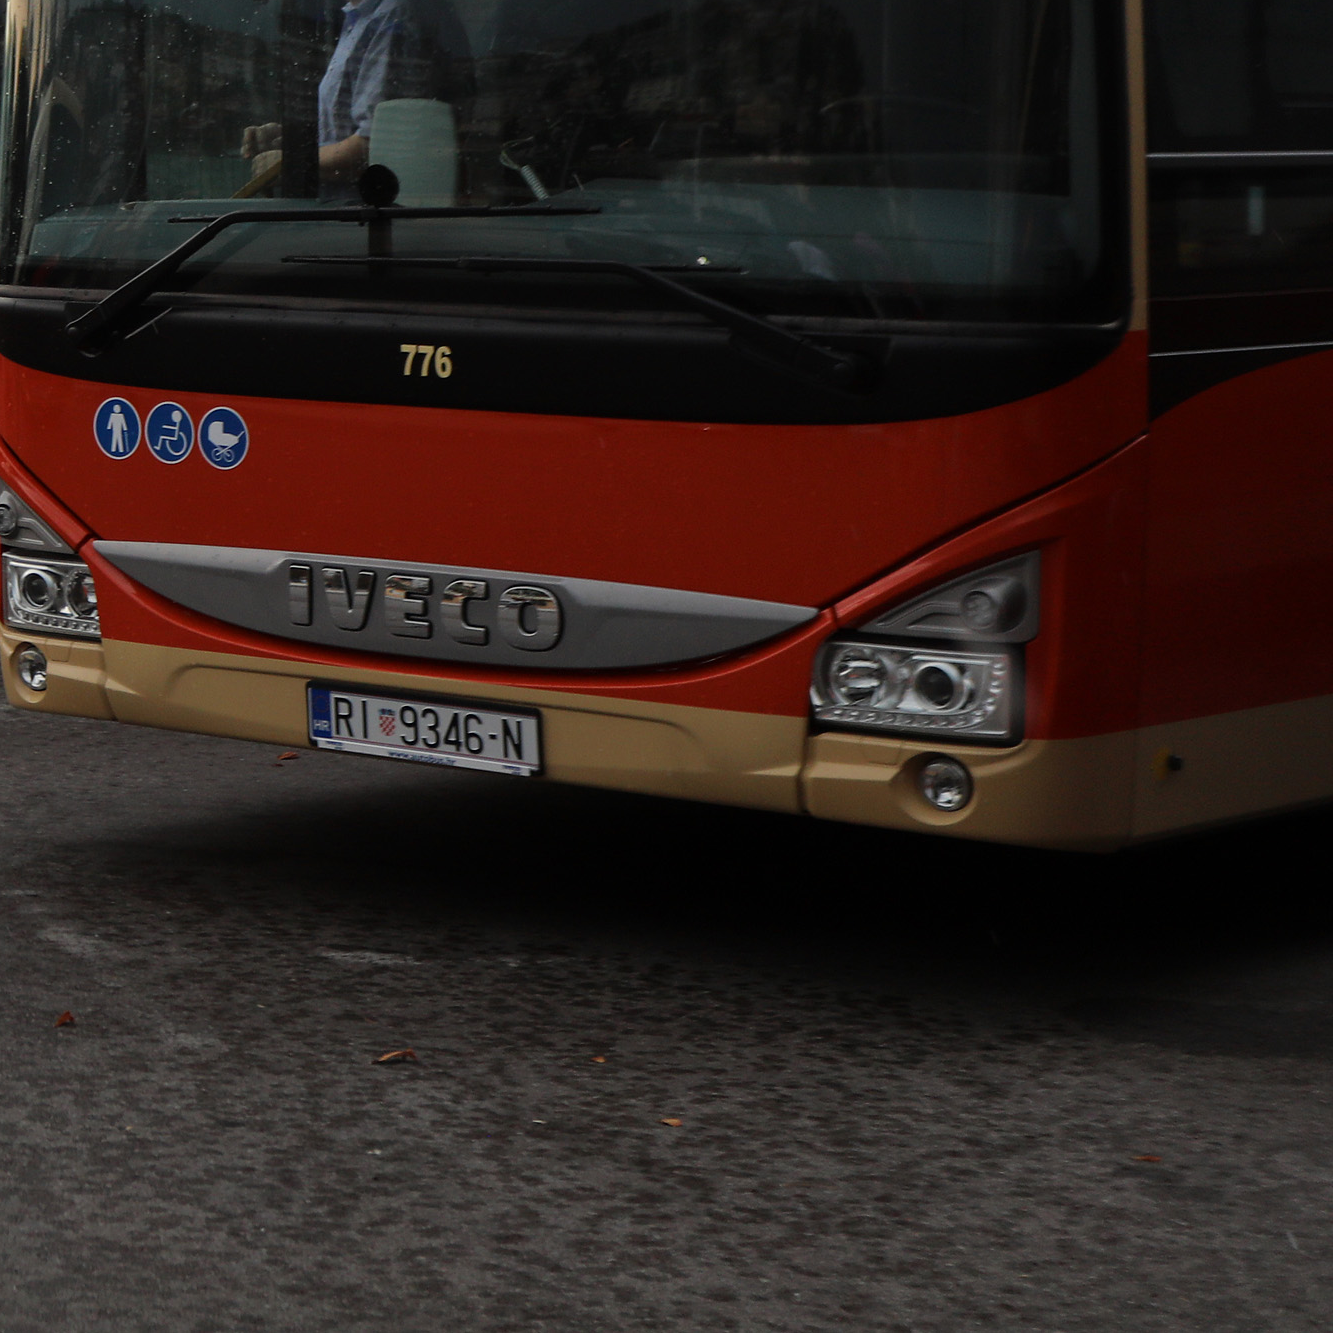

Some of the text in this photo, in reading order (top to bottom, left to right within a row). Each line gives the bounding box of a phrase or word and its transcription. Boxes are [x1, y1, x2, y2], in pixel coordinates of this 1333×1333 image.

[400, 344, 453, 379] 776
[289, 564, 565, 653] IVECO
[312, 697, 524, 761] HR RI 9346-N
